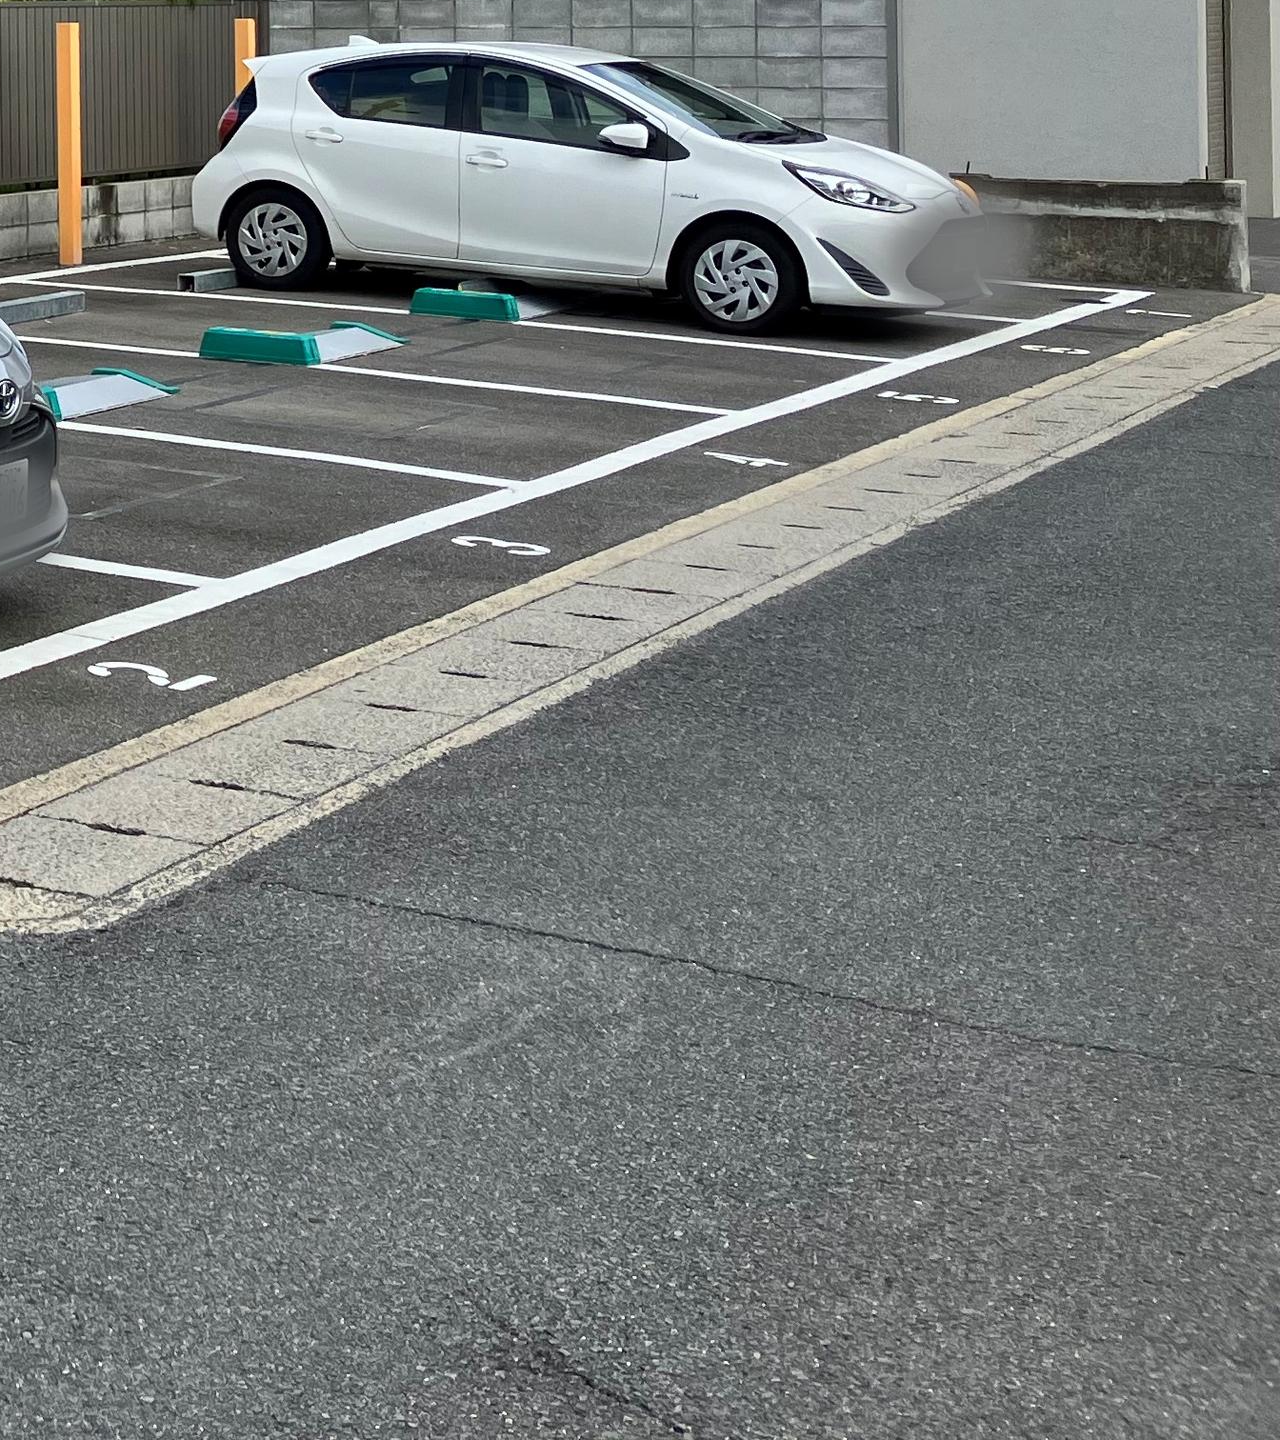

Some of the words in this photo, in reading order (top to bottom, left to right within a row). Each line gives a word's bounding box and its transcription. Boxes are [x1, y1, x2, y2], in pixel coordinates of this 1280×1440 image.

[877, 390, 959, 405] 5
[703, 450, 790, 468] 4
[450, 535, 552, 557] 3
[86, 660, 218, 692] 2
